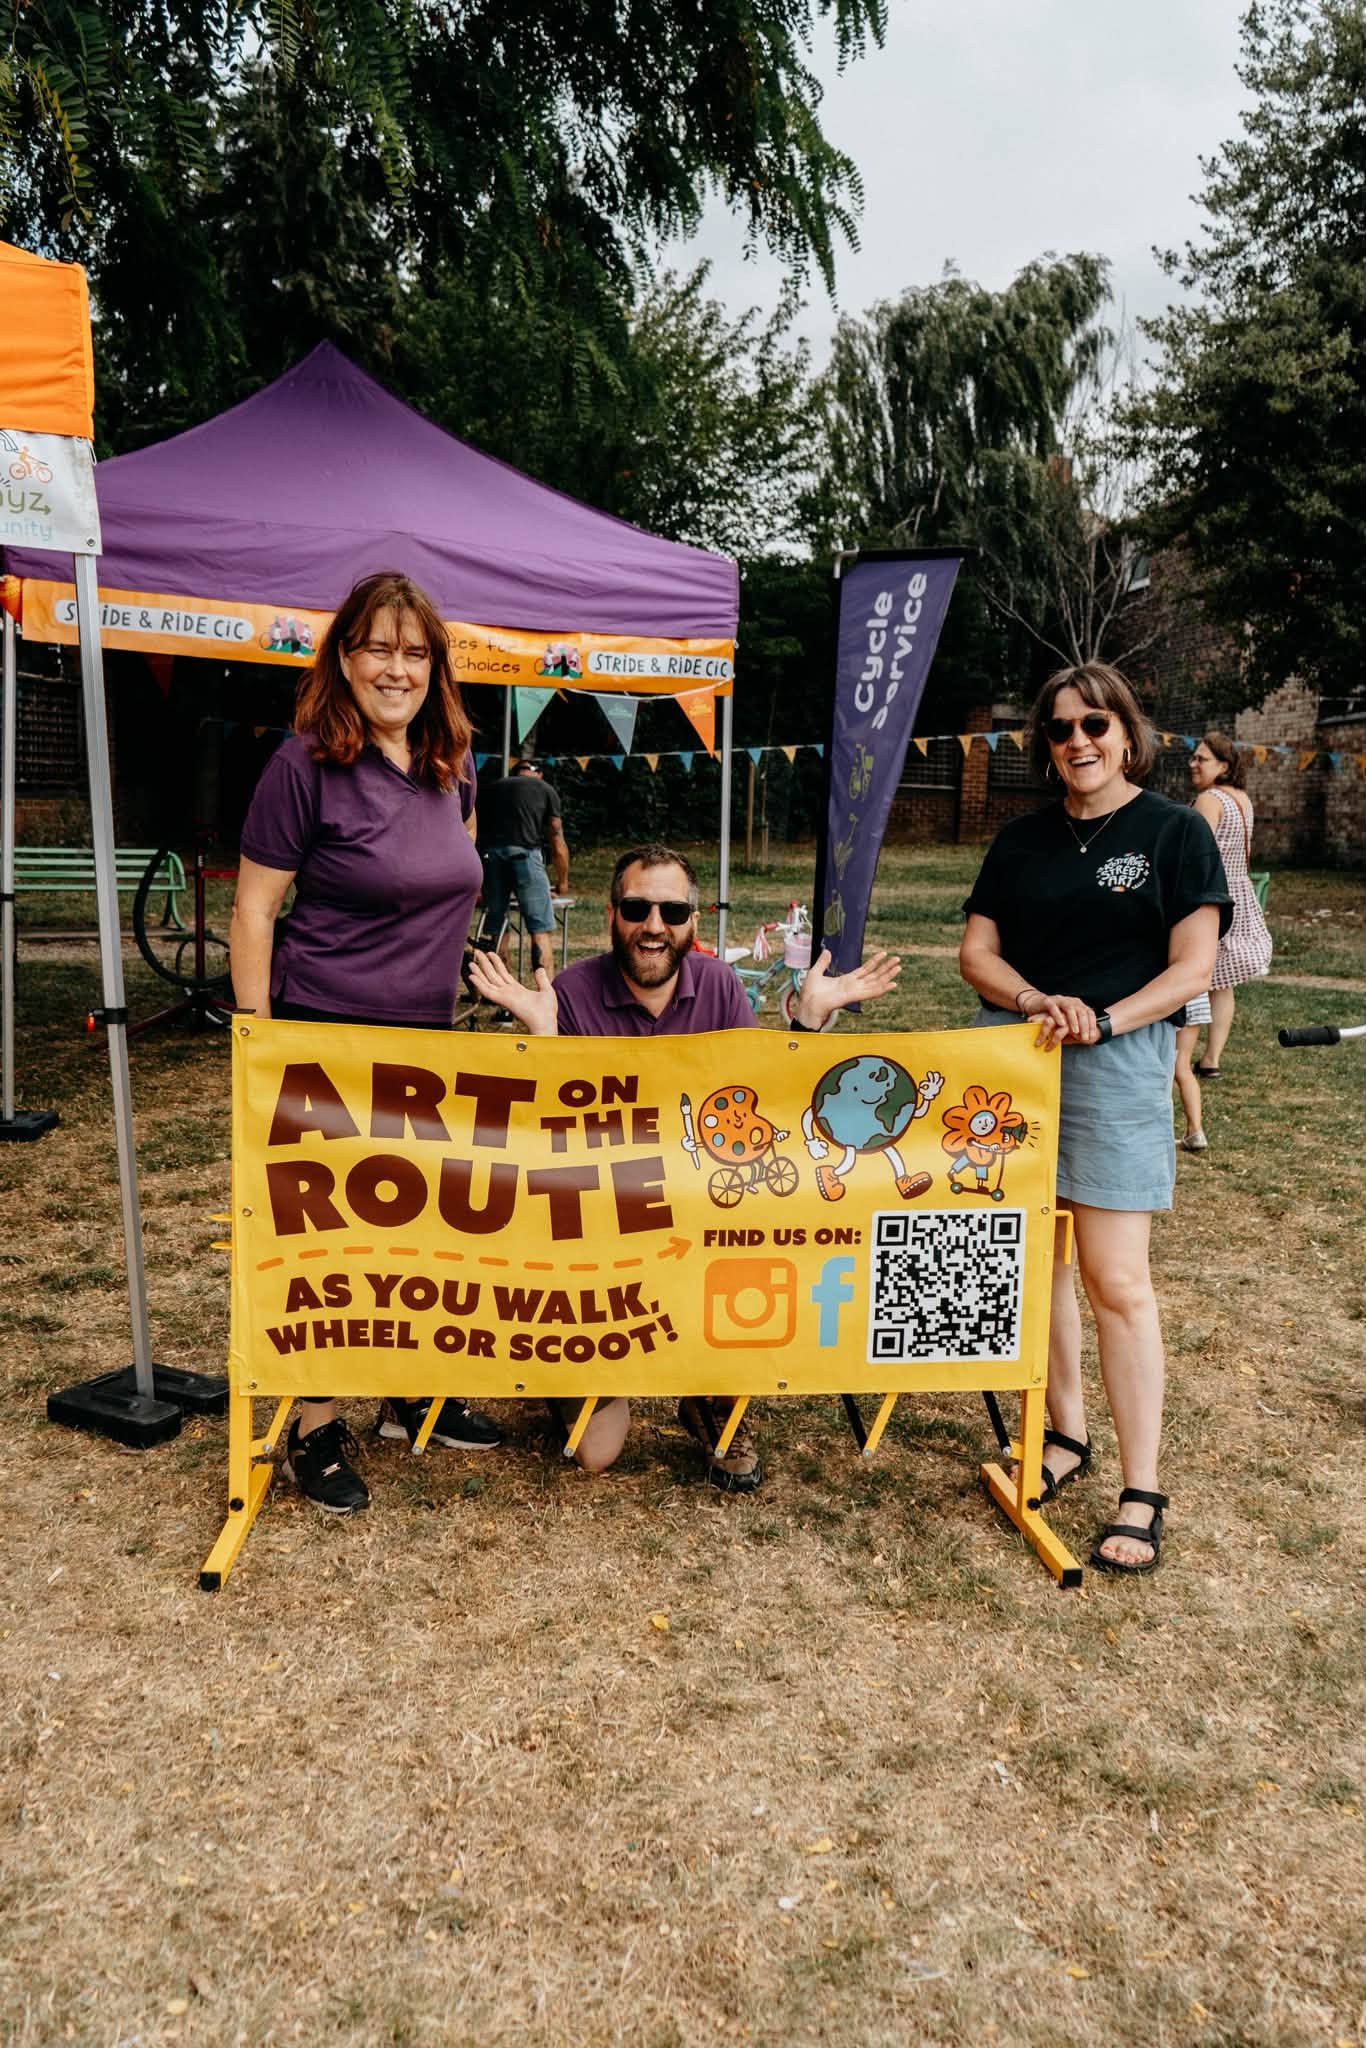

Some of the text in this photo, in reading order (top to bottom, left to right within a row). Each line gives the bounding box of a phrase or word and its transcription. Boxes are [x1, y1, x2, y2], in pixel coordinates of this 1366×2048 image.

[139, 609, 152, 628] &
[454, 656, 521, 674] Choices
[652, 657, 662, 673] &
[854, 591, 893, 713] Cycle
[872, 571, 928, 731] Service
[1100, 865, 1145, 881] STREET
[1107, 875, 1136, 888] ART
[268, 1062, 538, 1146] ART
[558, 1075, 639, 1108] ON
[540, 1107, 660, 1152] THE
[266, 1154, 674, 1240] ROUTE
[704, 1228, 863, 1248] FIND US ON:
[286, 1273, 660, 1325] AS YOU WALK,
[265, 1314, 679, 1364] WHEEL OR SCOOT!
